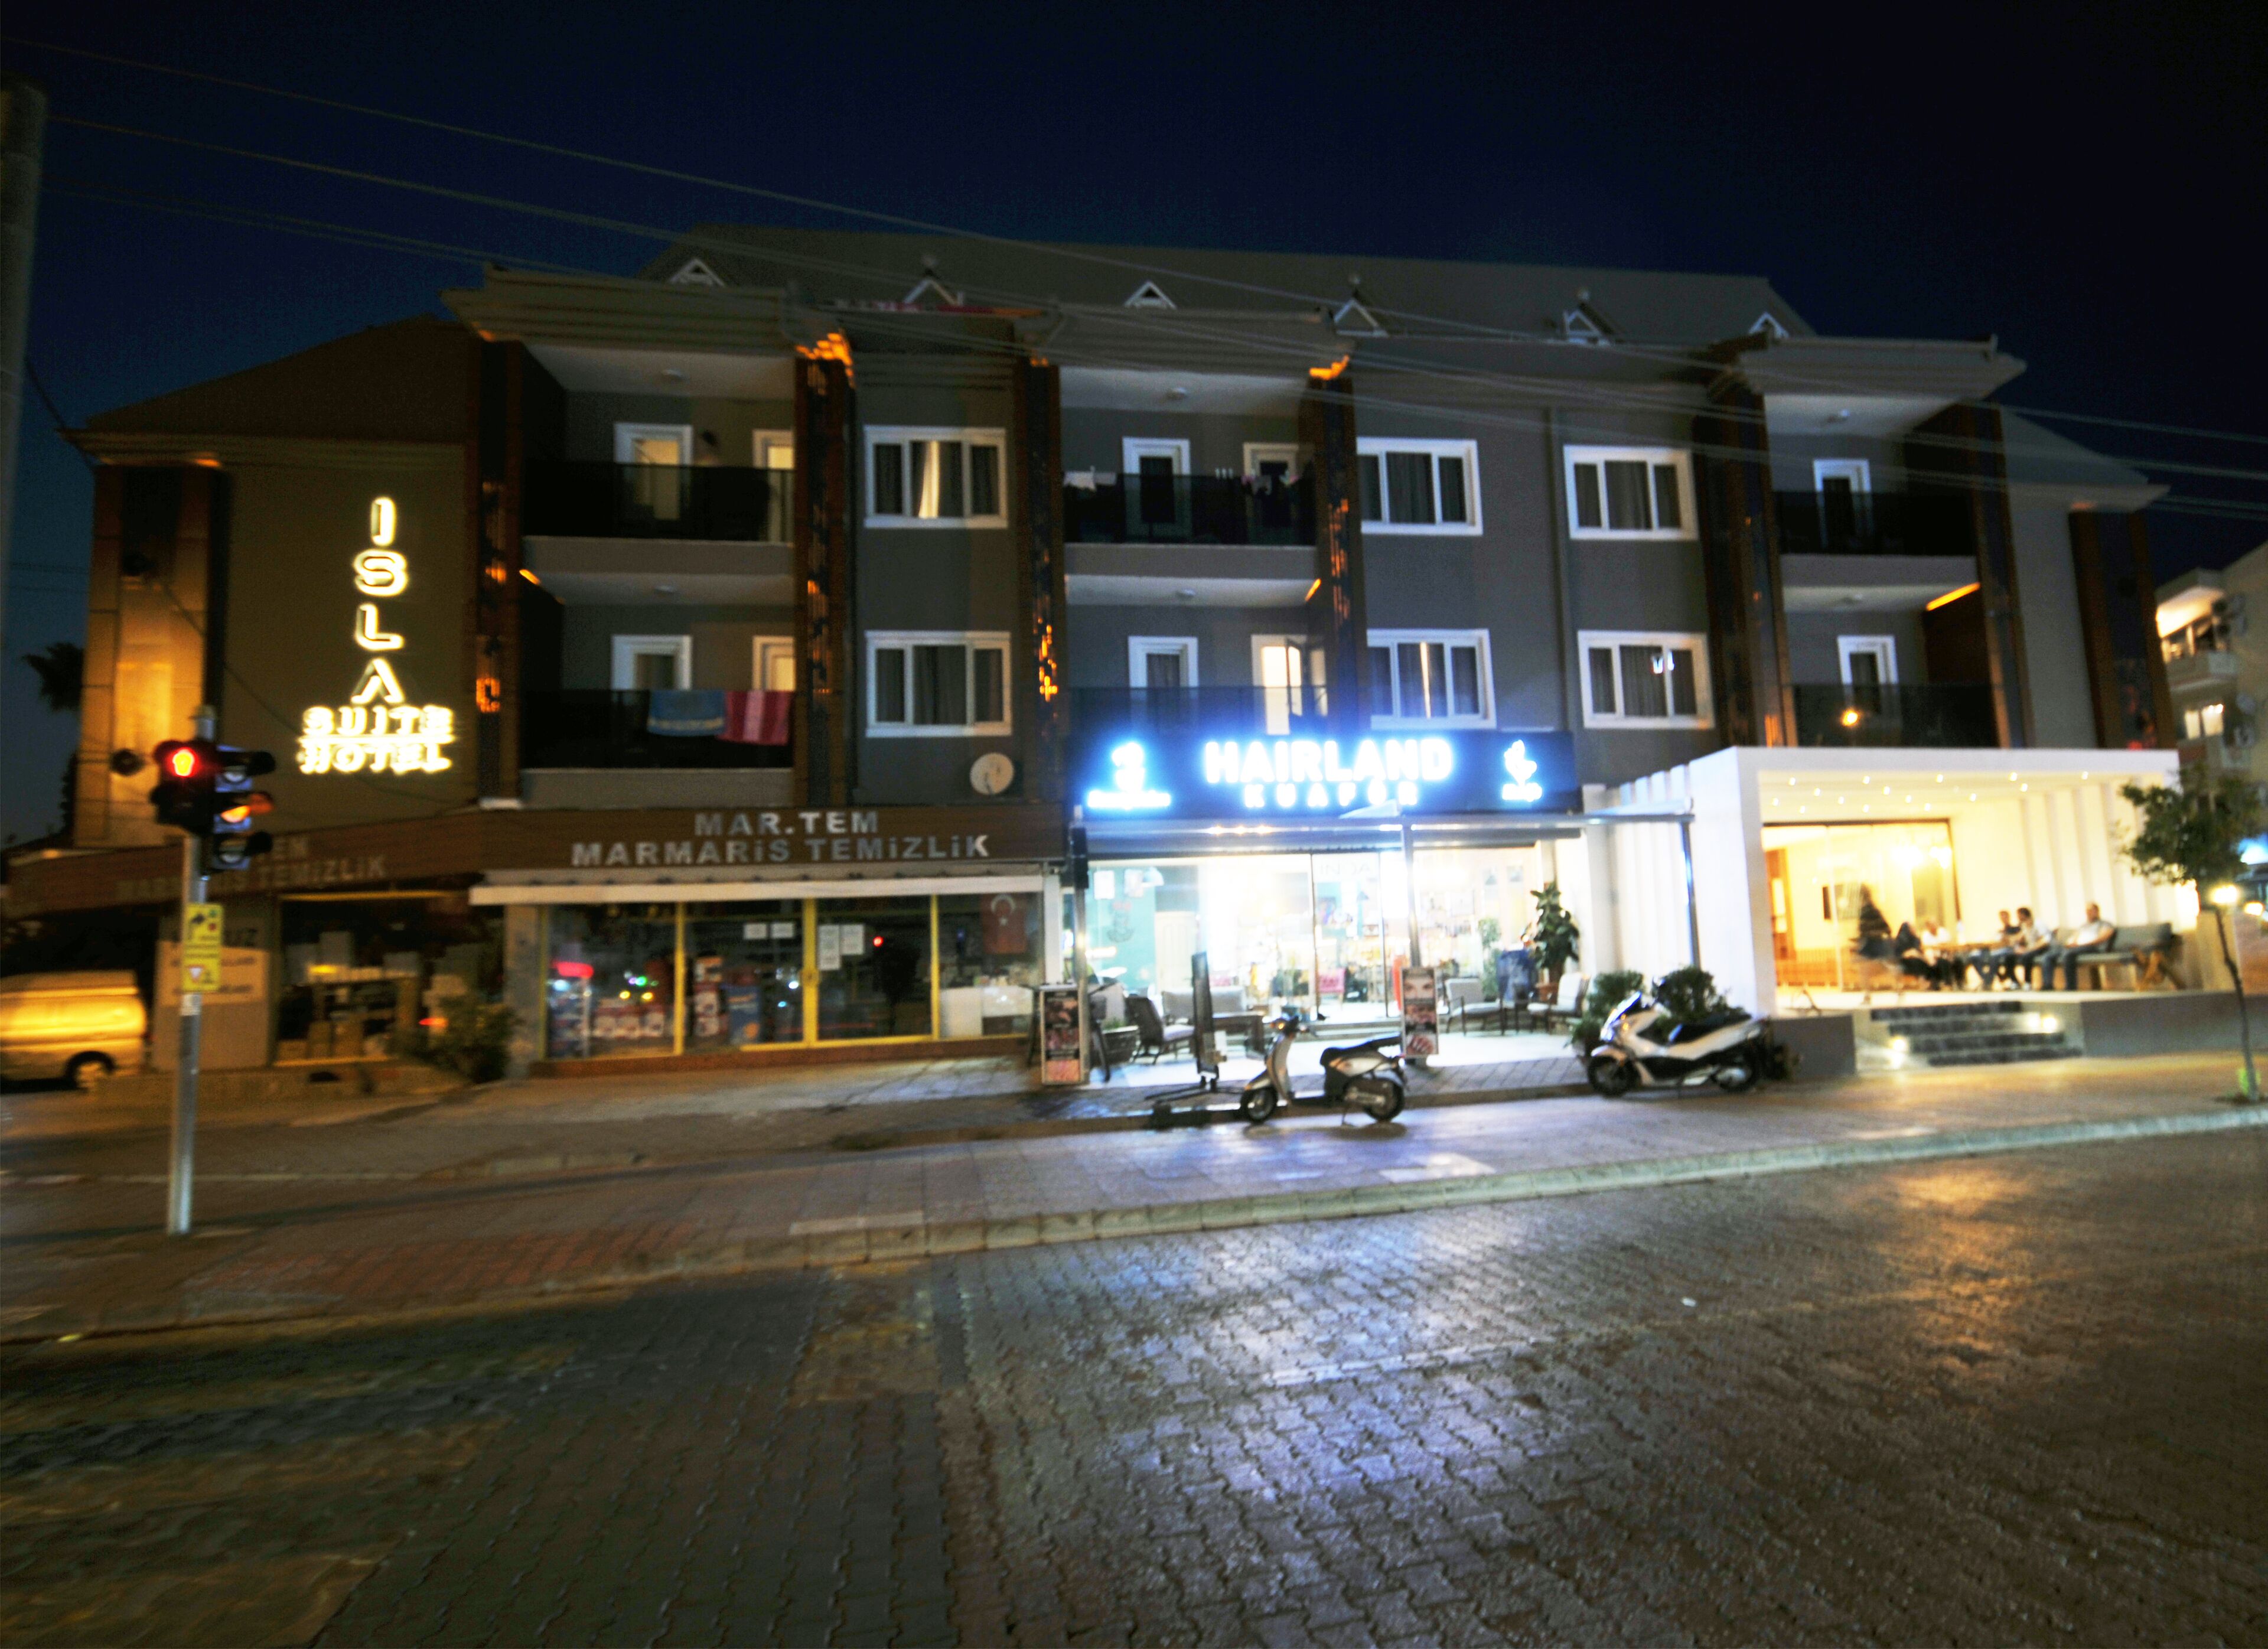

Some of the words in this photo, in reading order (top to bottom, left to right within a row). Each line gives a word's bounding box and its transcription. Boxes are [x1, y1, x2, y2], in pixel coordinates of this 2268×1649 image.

[353, 496, 408, 704] ISLA
[302, 705, 454, 736] SUITE
[296, 742, 452, 774] HOTEL
[1205, 738, 1452, 783] HAIRLAND
[694, 812, 878, 836] MAR.TEM
